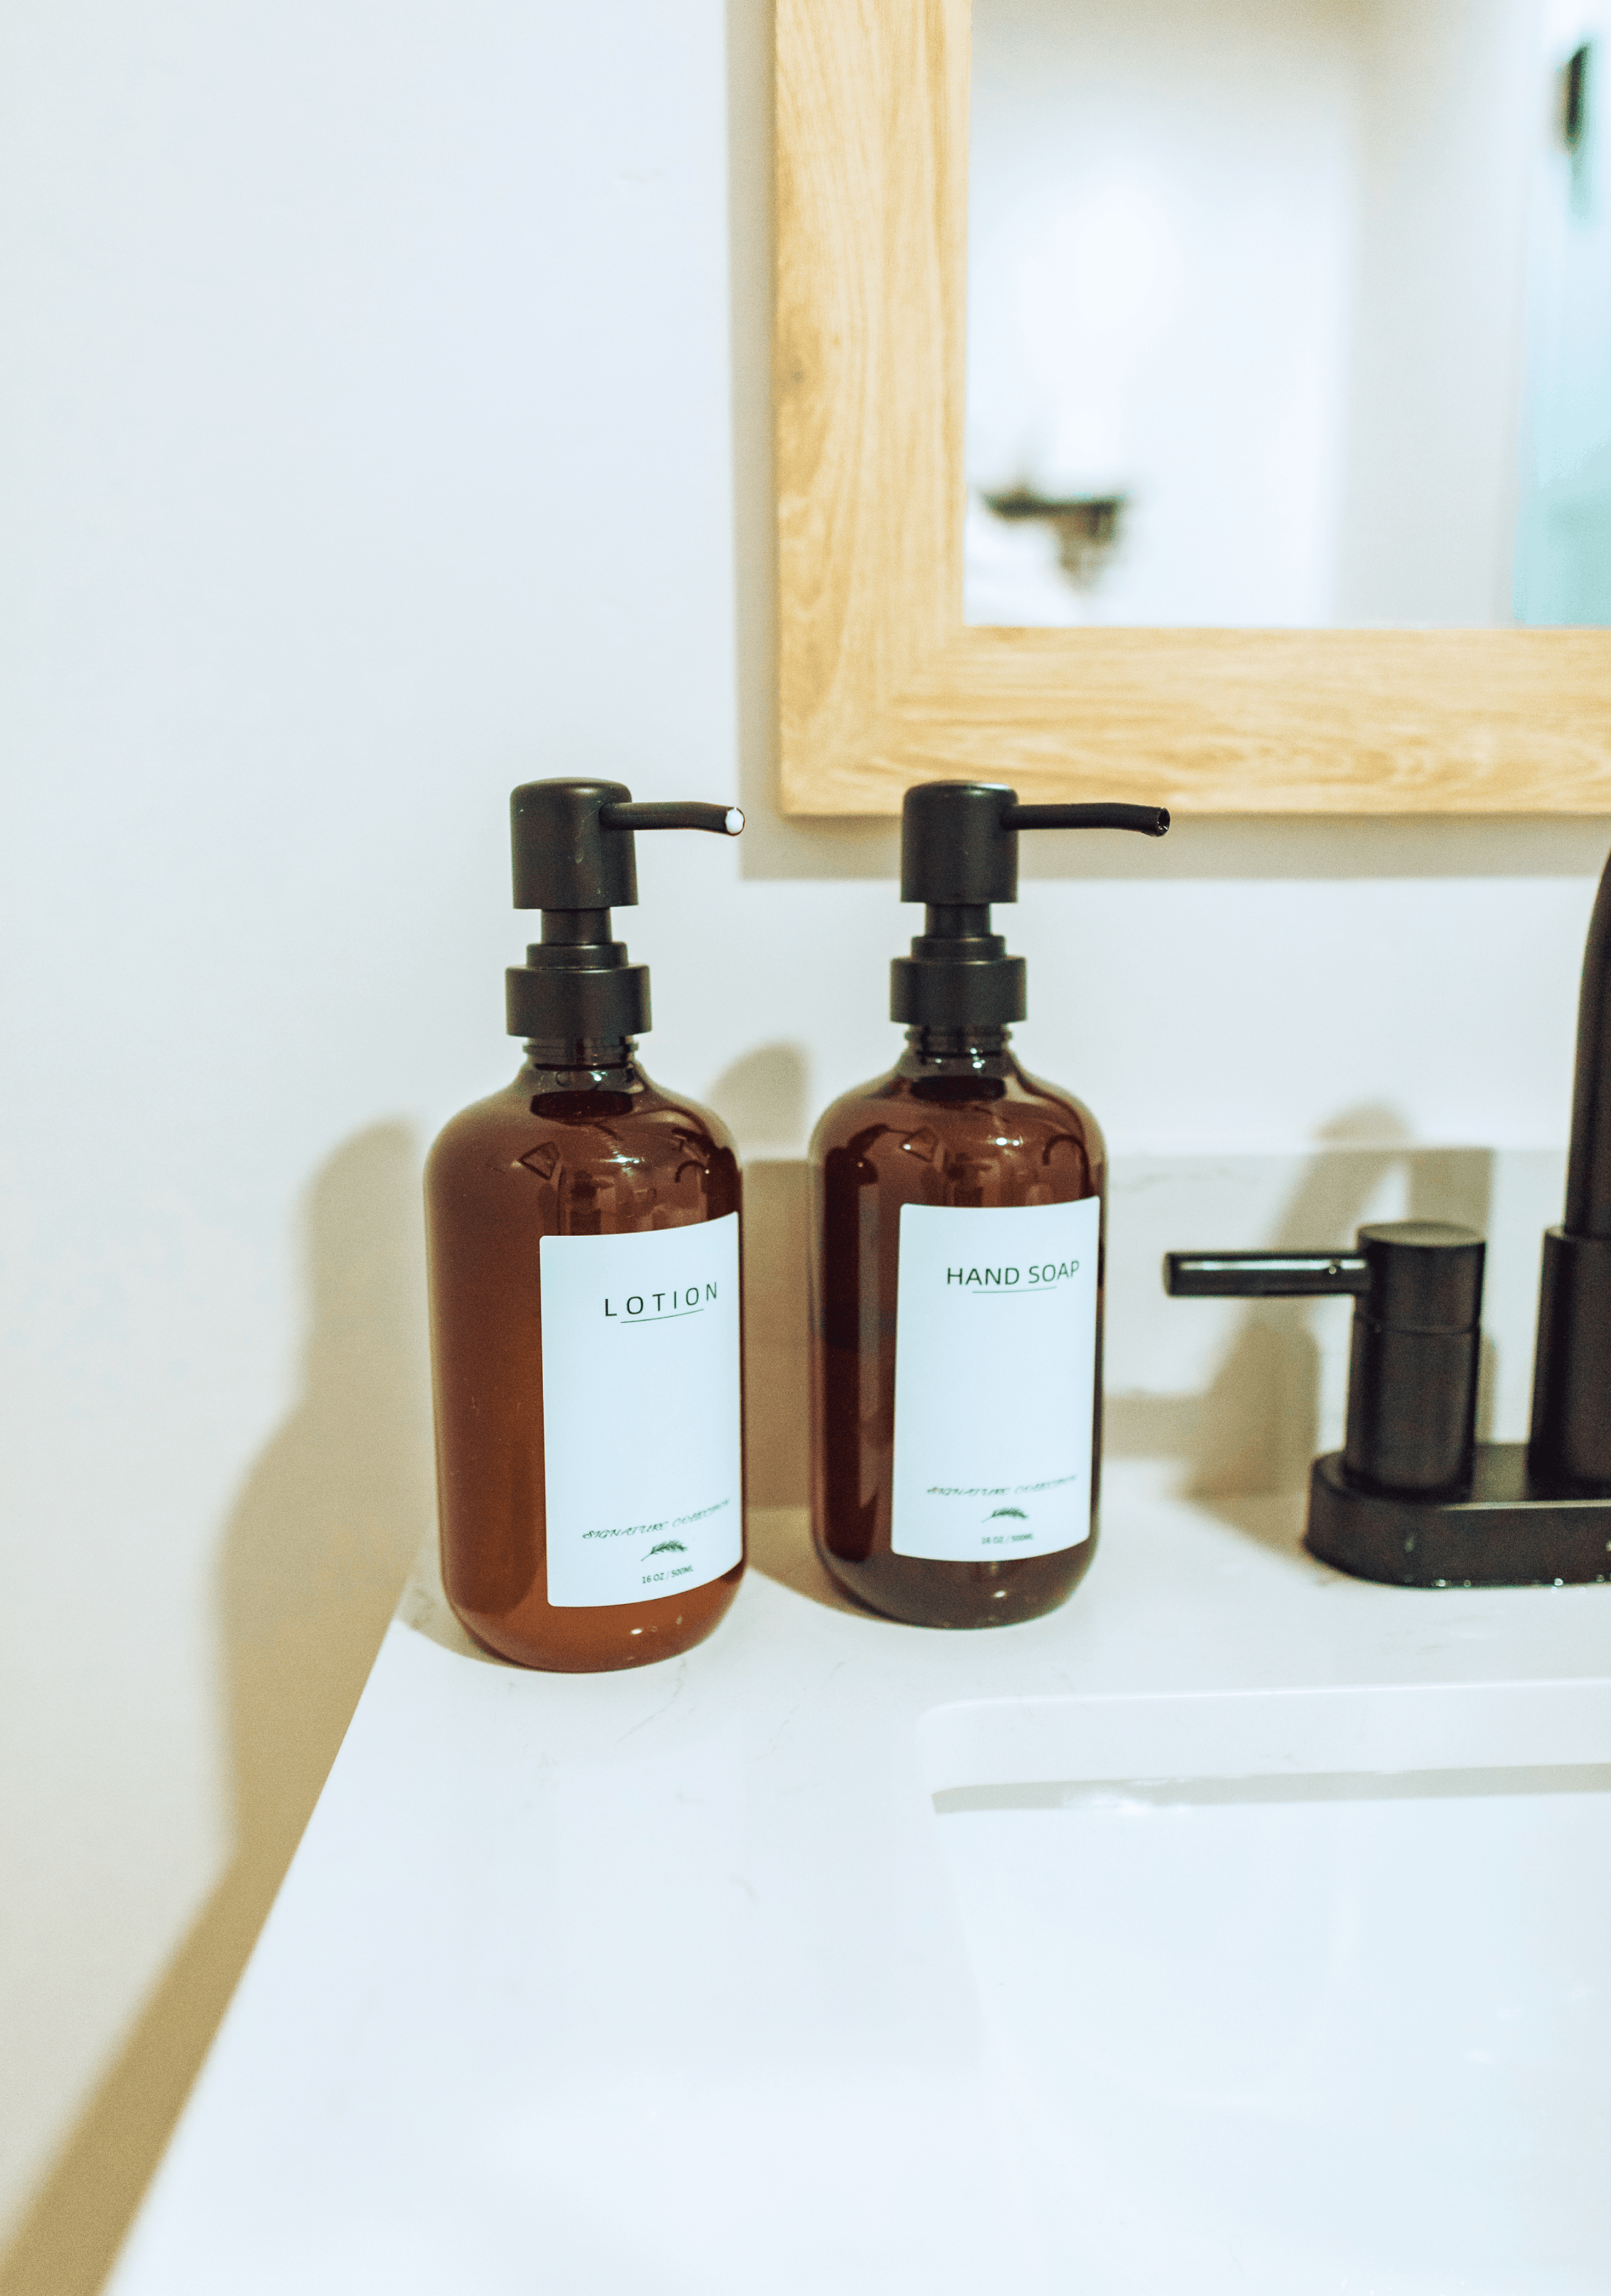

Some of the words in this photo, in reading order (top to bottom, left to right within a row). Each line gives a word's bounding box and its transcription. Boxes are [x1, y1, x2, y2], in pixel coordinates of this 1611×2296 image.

[946, 1267, 1020, 1286] HAND
[1028, 1260, 1080, 1284] SOAP
[605, 1281, 717, 1317] LOTION
[582, 1520, 669, 1539] SIGNATURE
[642, 1575, 652, 1584] 16
[653, 1573, 665, 1582] OZ
